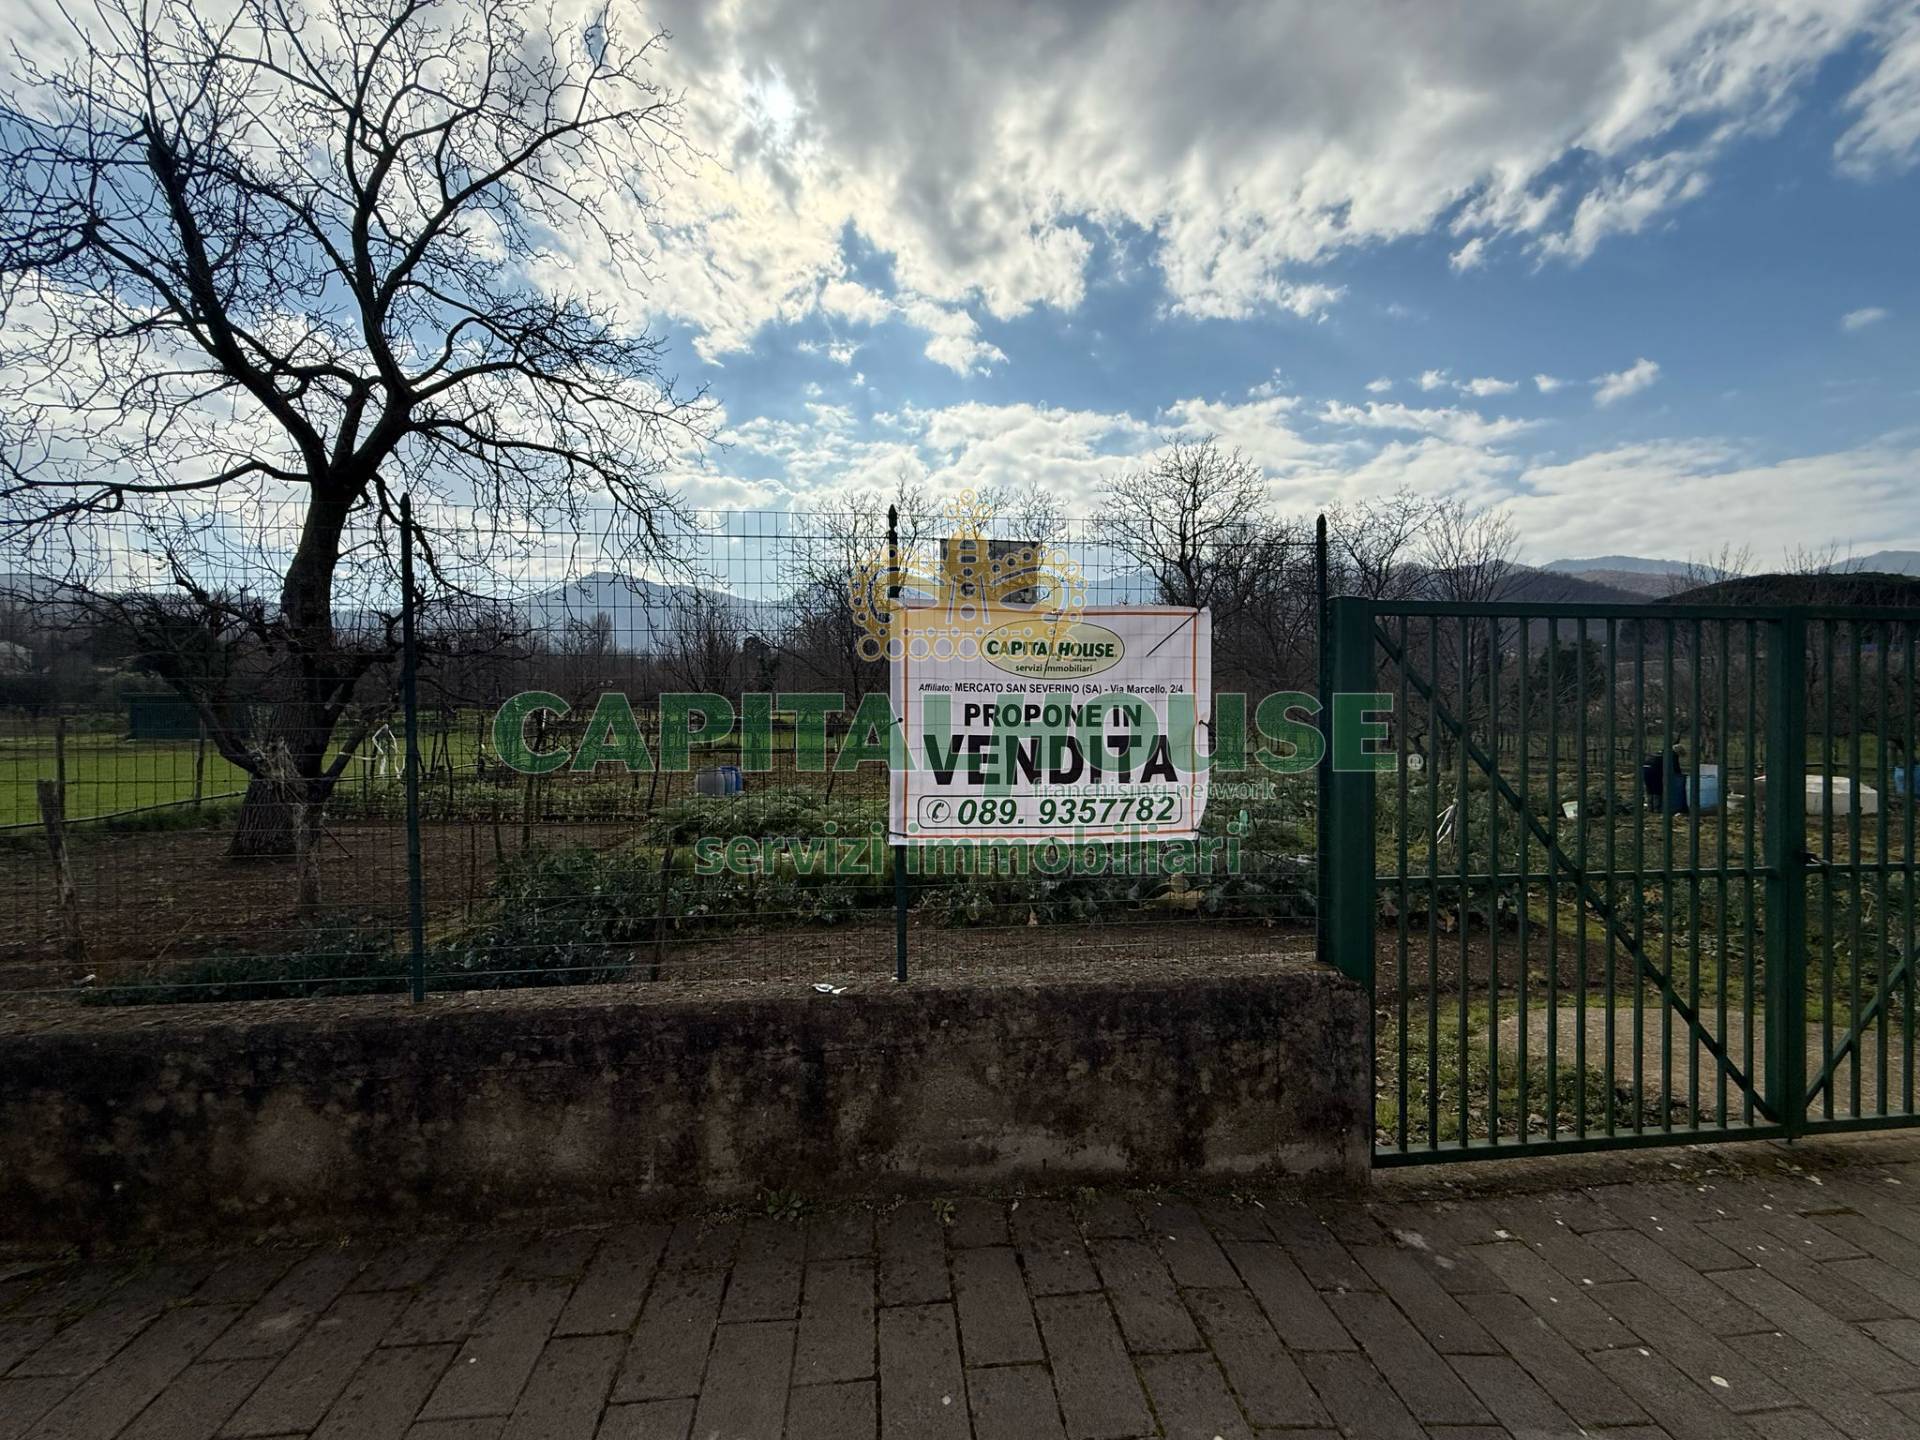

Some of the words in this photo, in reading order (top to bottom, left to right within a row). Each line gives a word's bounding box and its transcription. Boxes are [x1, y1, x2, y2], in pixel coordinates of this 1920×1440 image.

[1057, 641, 1115, 661] HOUSE
[1015, 664, 1042, 672] servizi
[919, 682, 952, 692] Affiliato:
[955, 682, 1003, 693] MERCATO
[1006, 683, 1027, 693] SAN
[1029, 684, 1079, 694] SEVERINO
[1082, 684, 1102, 695] (SA)
[1110, 684, 1124, 693] Via
[1127, 685, 1168, 694] Marcello,
[1170, 684, 1184, 694] 2/4
[964, 703, 1102, 728] PROPONE
[1113, 704, 1142, 728] IN
[923, 734, 1178, 786] VENDITA
[957, 798, 1024, 825] 089.
[1038, 797, 1175, 825] 9357782
